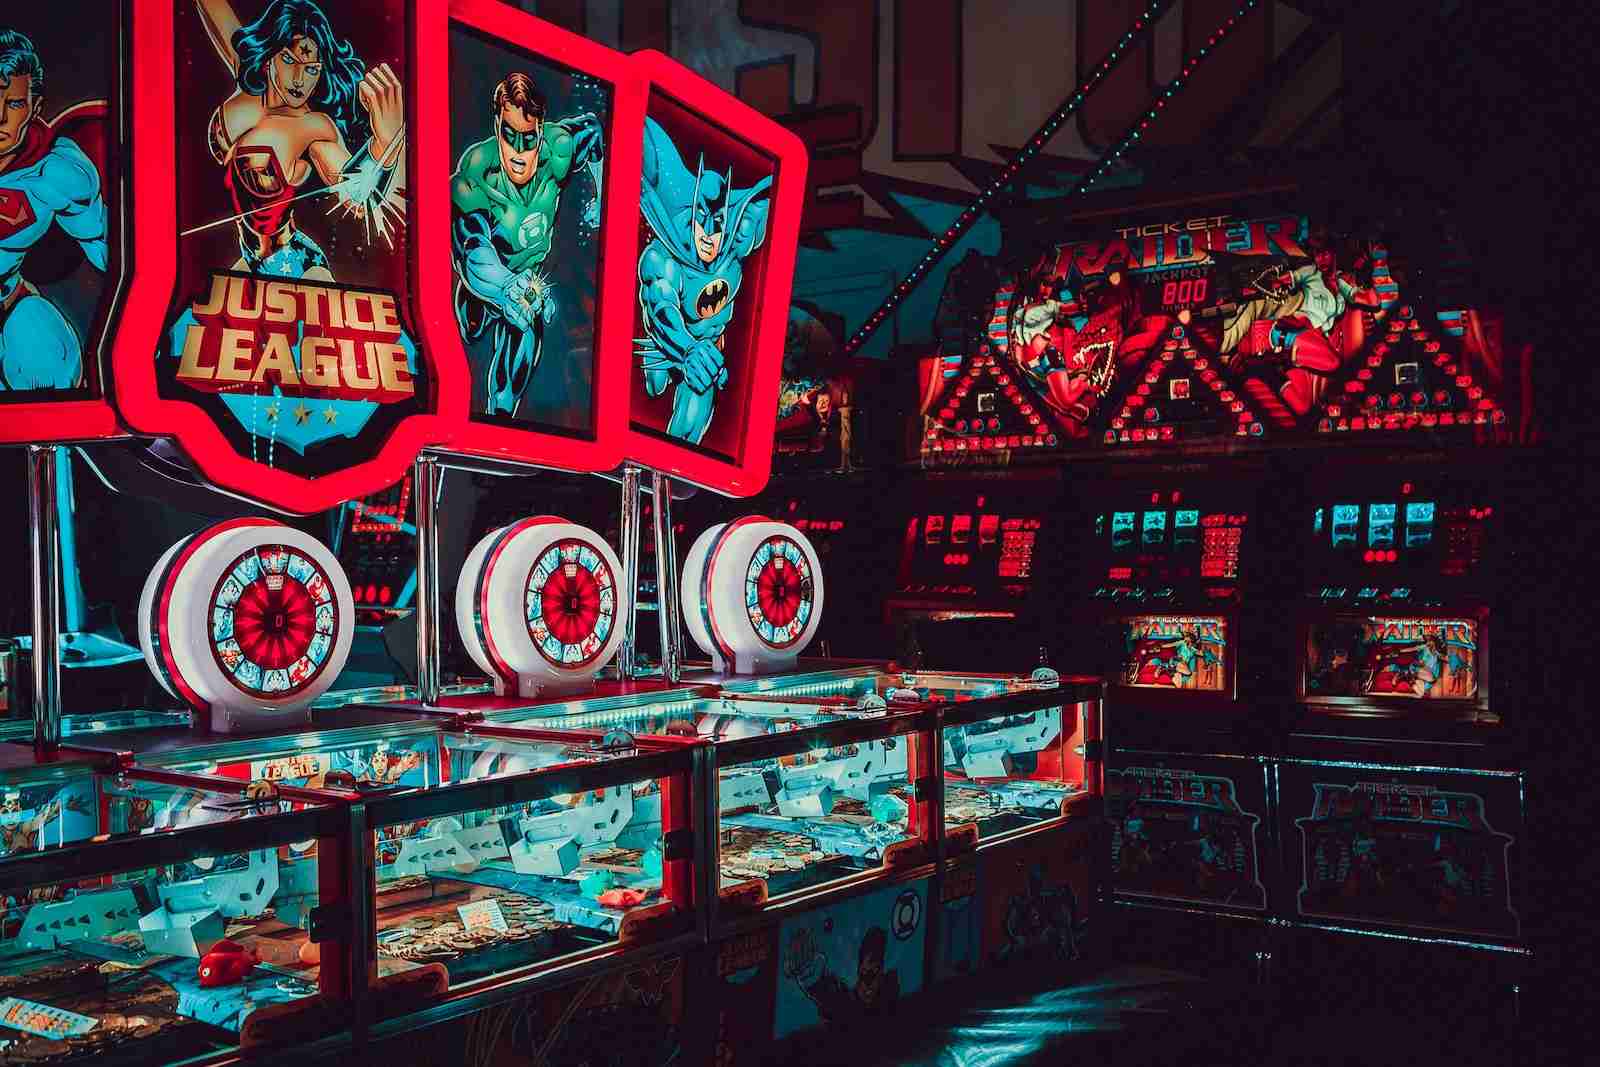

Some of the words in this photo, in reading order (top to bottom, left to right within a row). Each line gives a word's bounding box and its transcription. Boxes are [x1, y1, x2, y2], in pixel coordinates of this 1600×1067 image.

[1055, 217, 1310, 281] RAIDER
[1115, 215, 1233, 241] TICKET
[192, 273, 401, 334] JUSTICE
[1162, 278, 1208, 305] 800
[175, 323, 416, 393] LEAGUE
